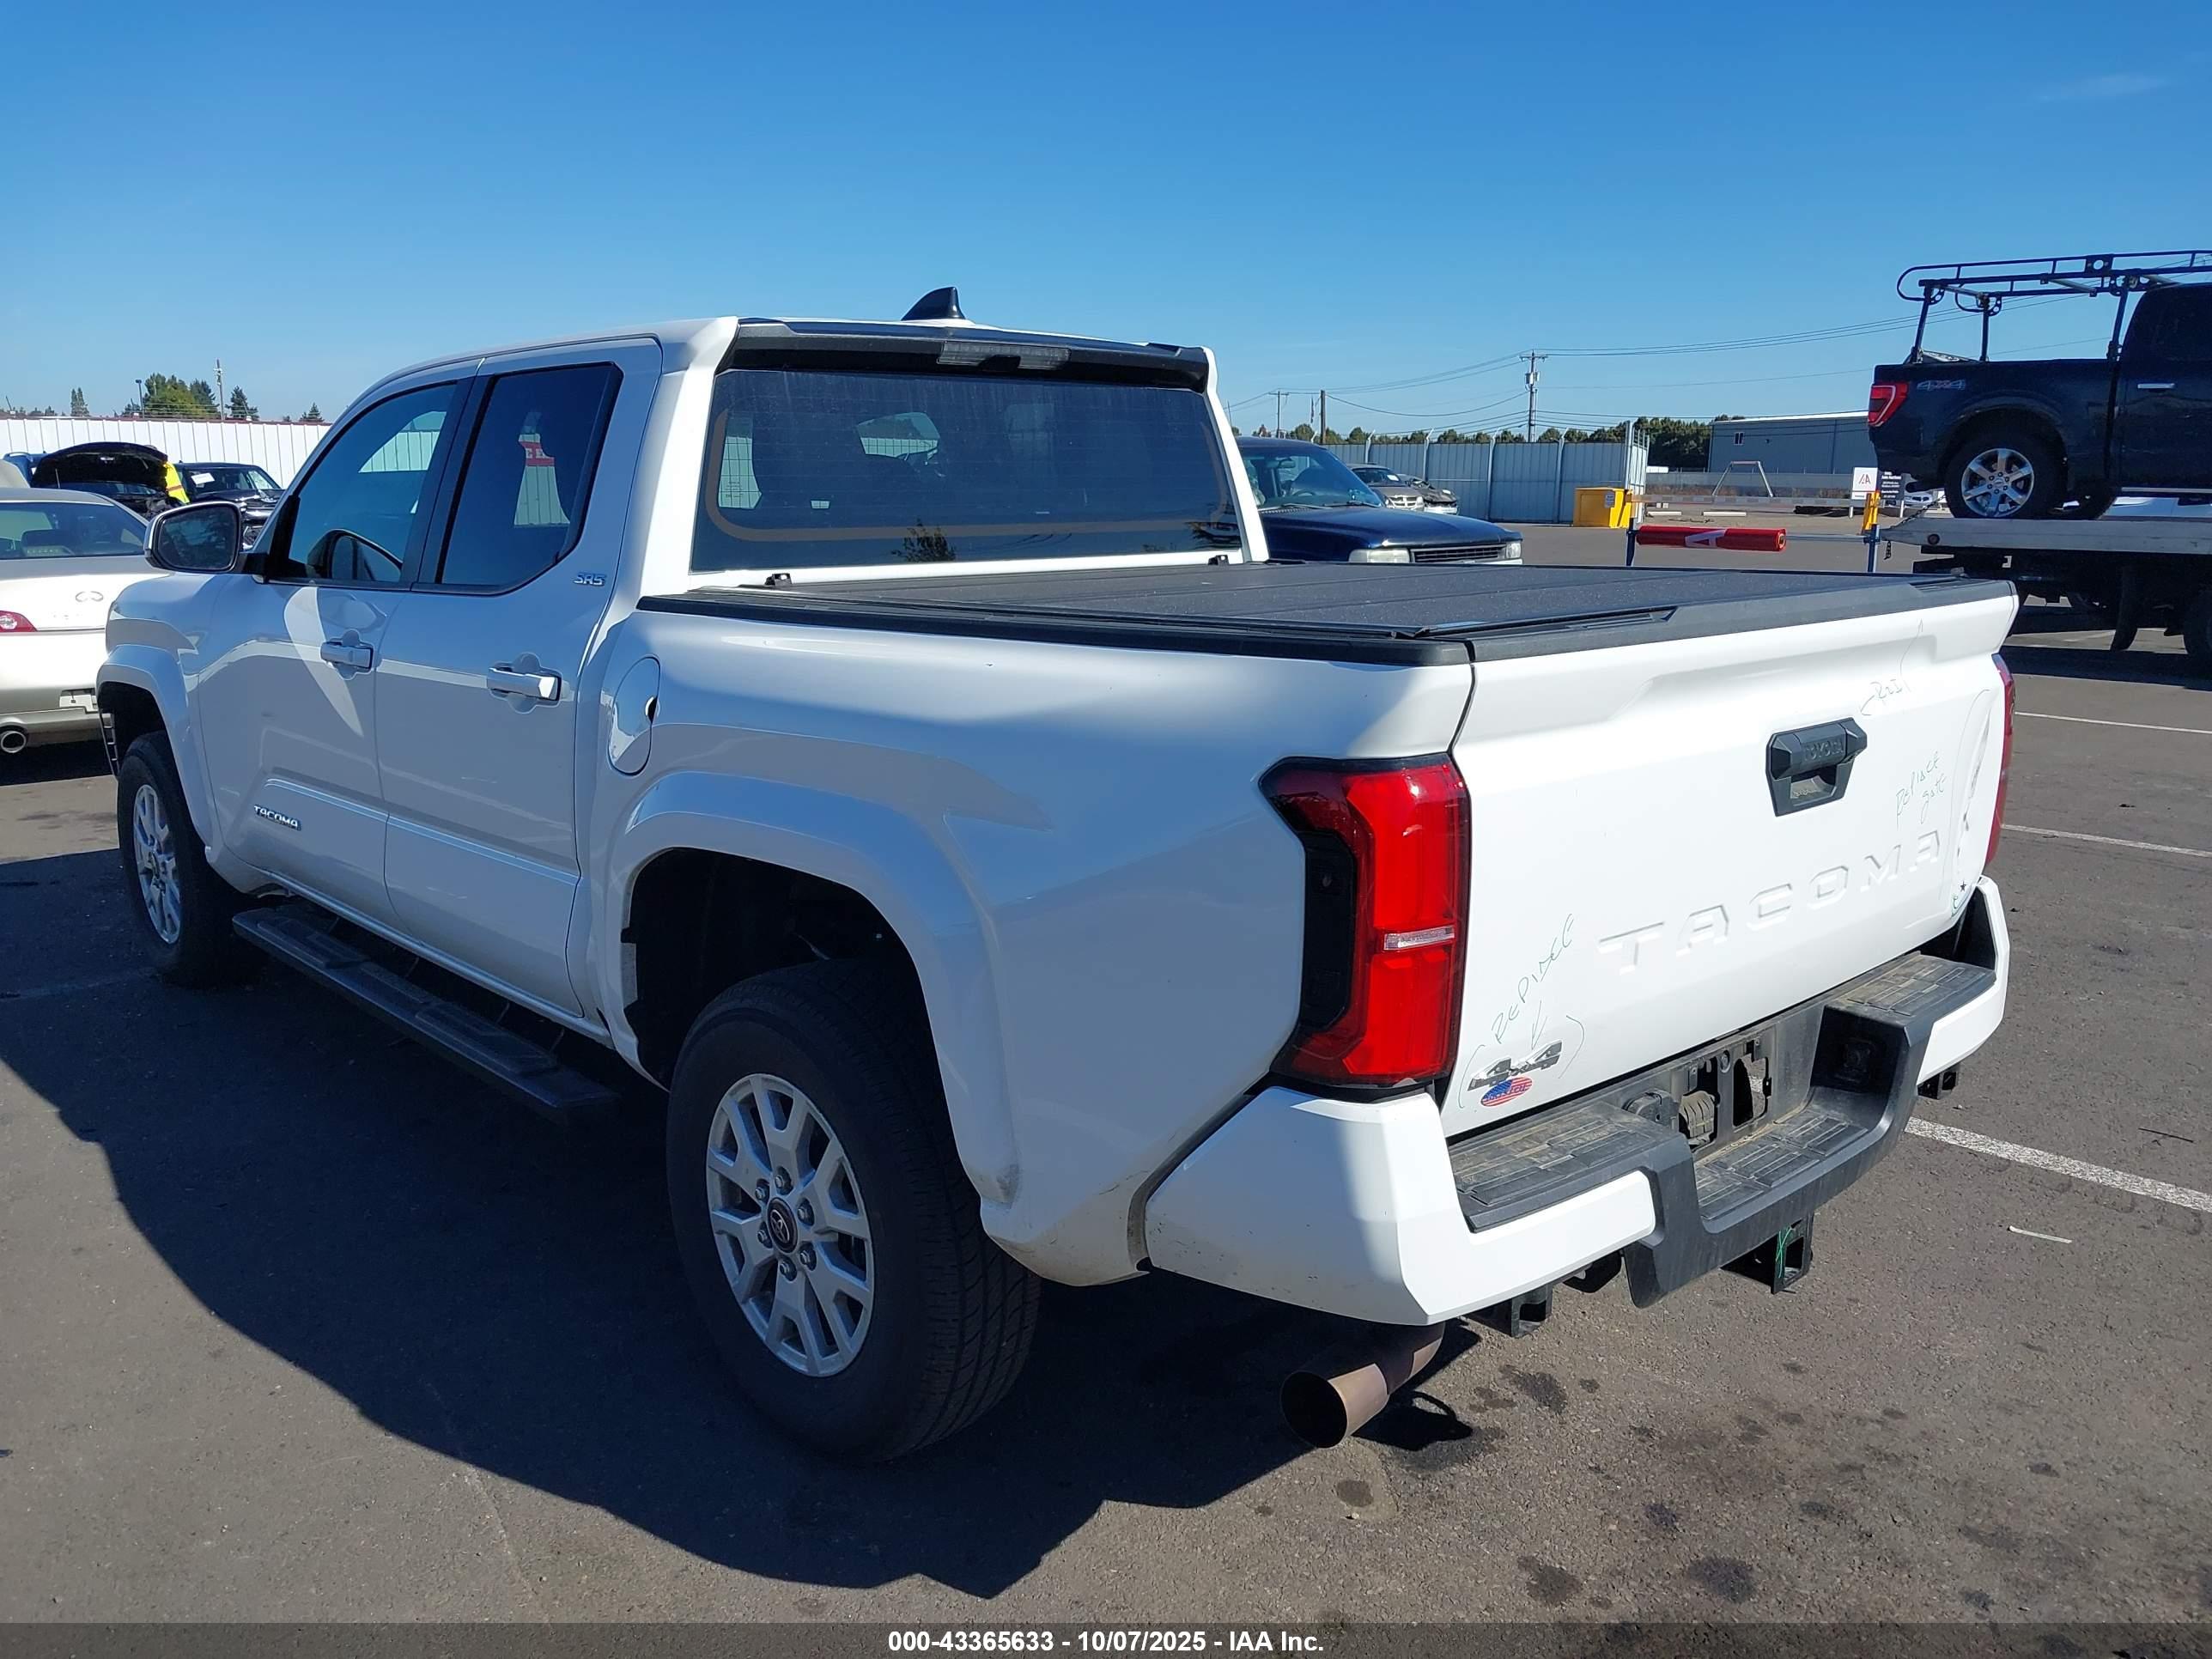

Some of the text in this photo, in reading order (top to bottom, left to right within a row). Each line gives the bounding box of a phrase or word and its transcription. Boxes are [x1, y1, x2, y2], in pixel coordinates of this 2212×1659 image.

[574, 573, 603, 586] SR5
[253, 805, 301, 831] TACOMA
[1597, 830, 1941, 975] TACOMA
